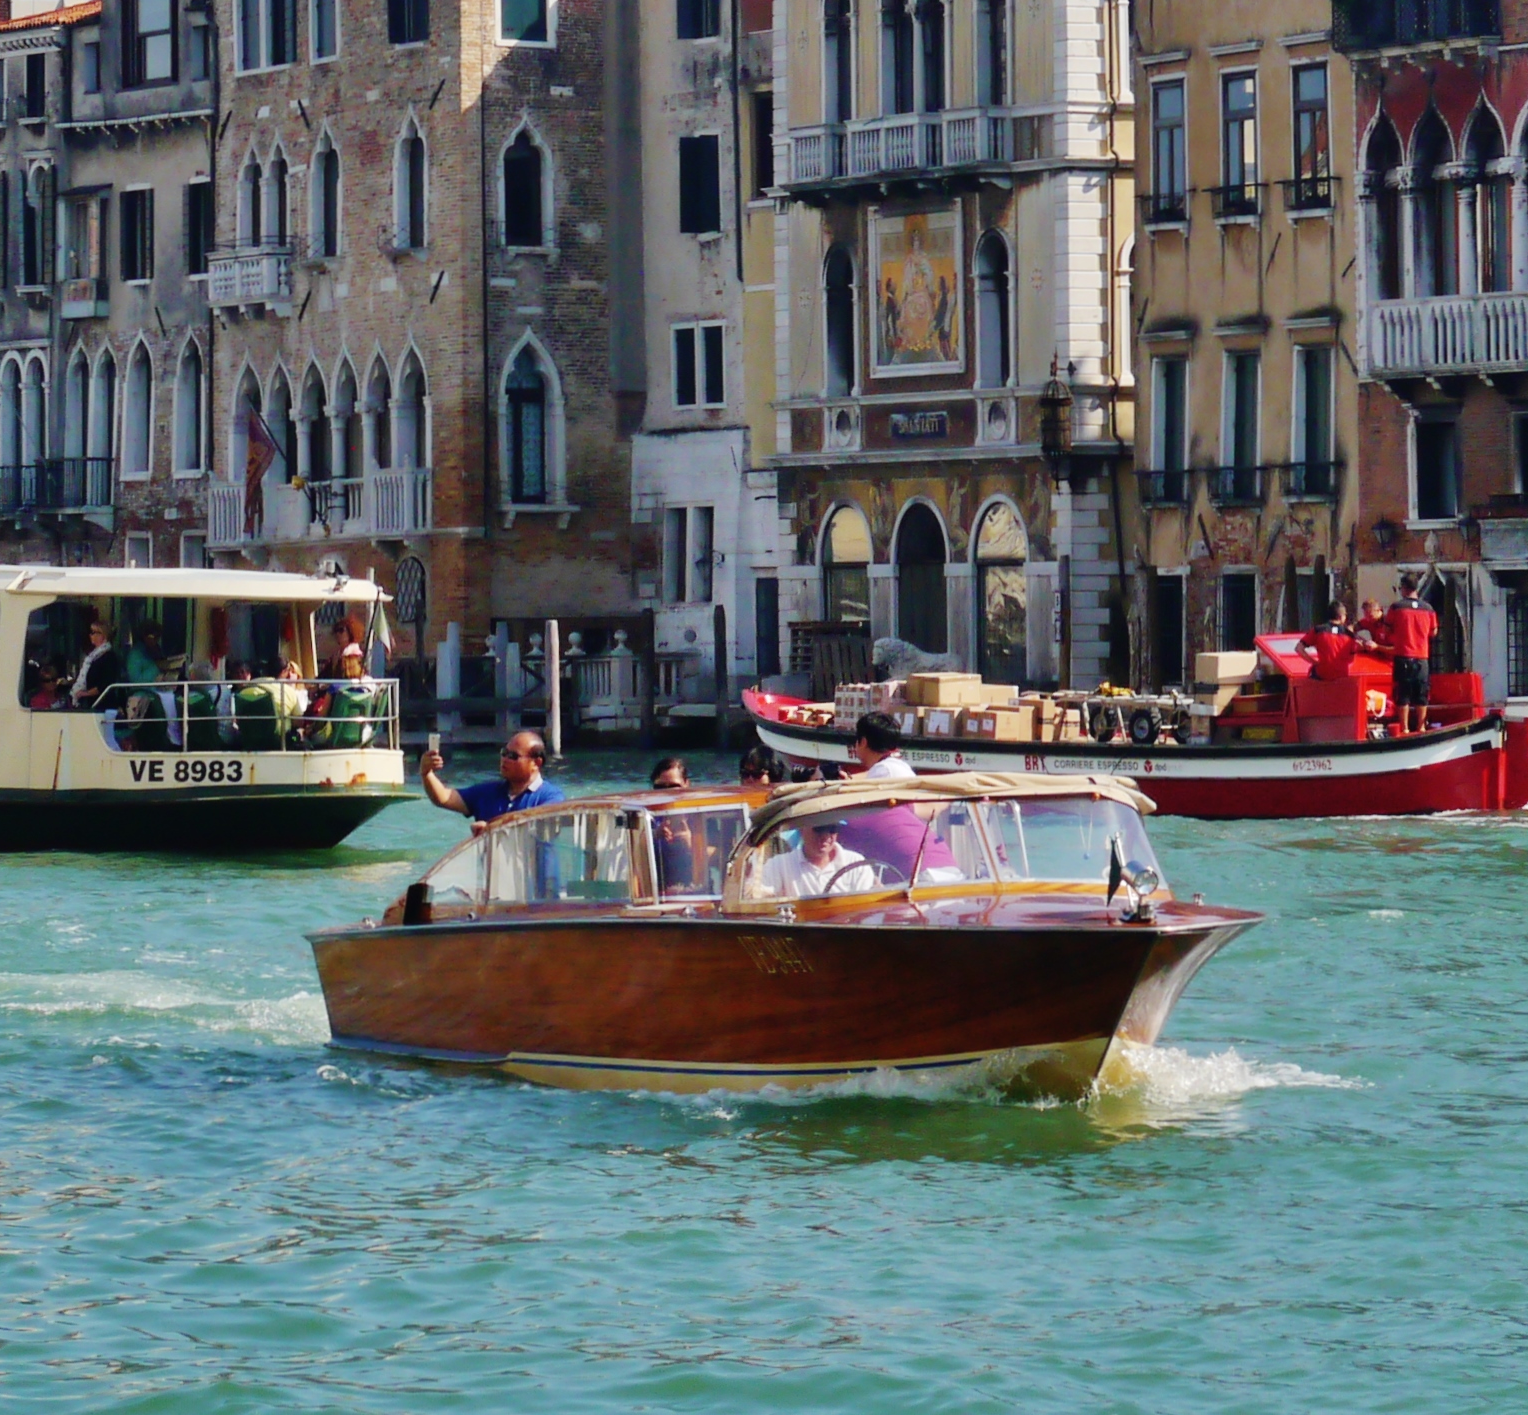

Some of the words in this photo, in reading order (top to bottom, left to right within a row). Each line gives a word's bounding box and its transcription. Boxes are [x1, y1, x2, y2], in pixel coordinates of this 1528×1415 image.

[912, 752, 950, 763] ESPRESSO
[1024, 754, 1046, 772] BRT
[1054, 758, 1094, 770] CORRIERE
[1097, 759, 1139, 771] ESPRESSO
[129, 760, 164, 782] VE
[174, 760, 243, 782] 8983
